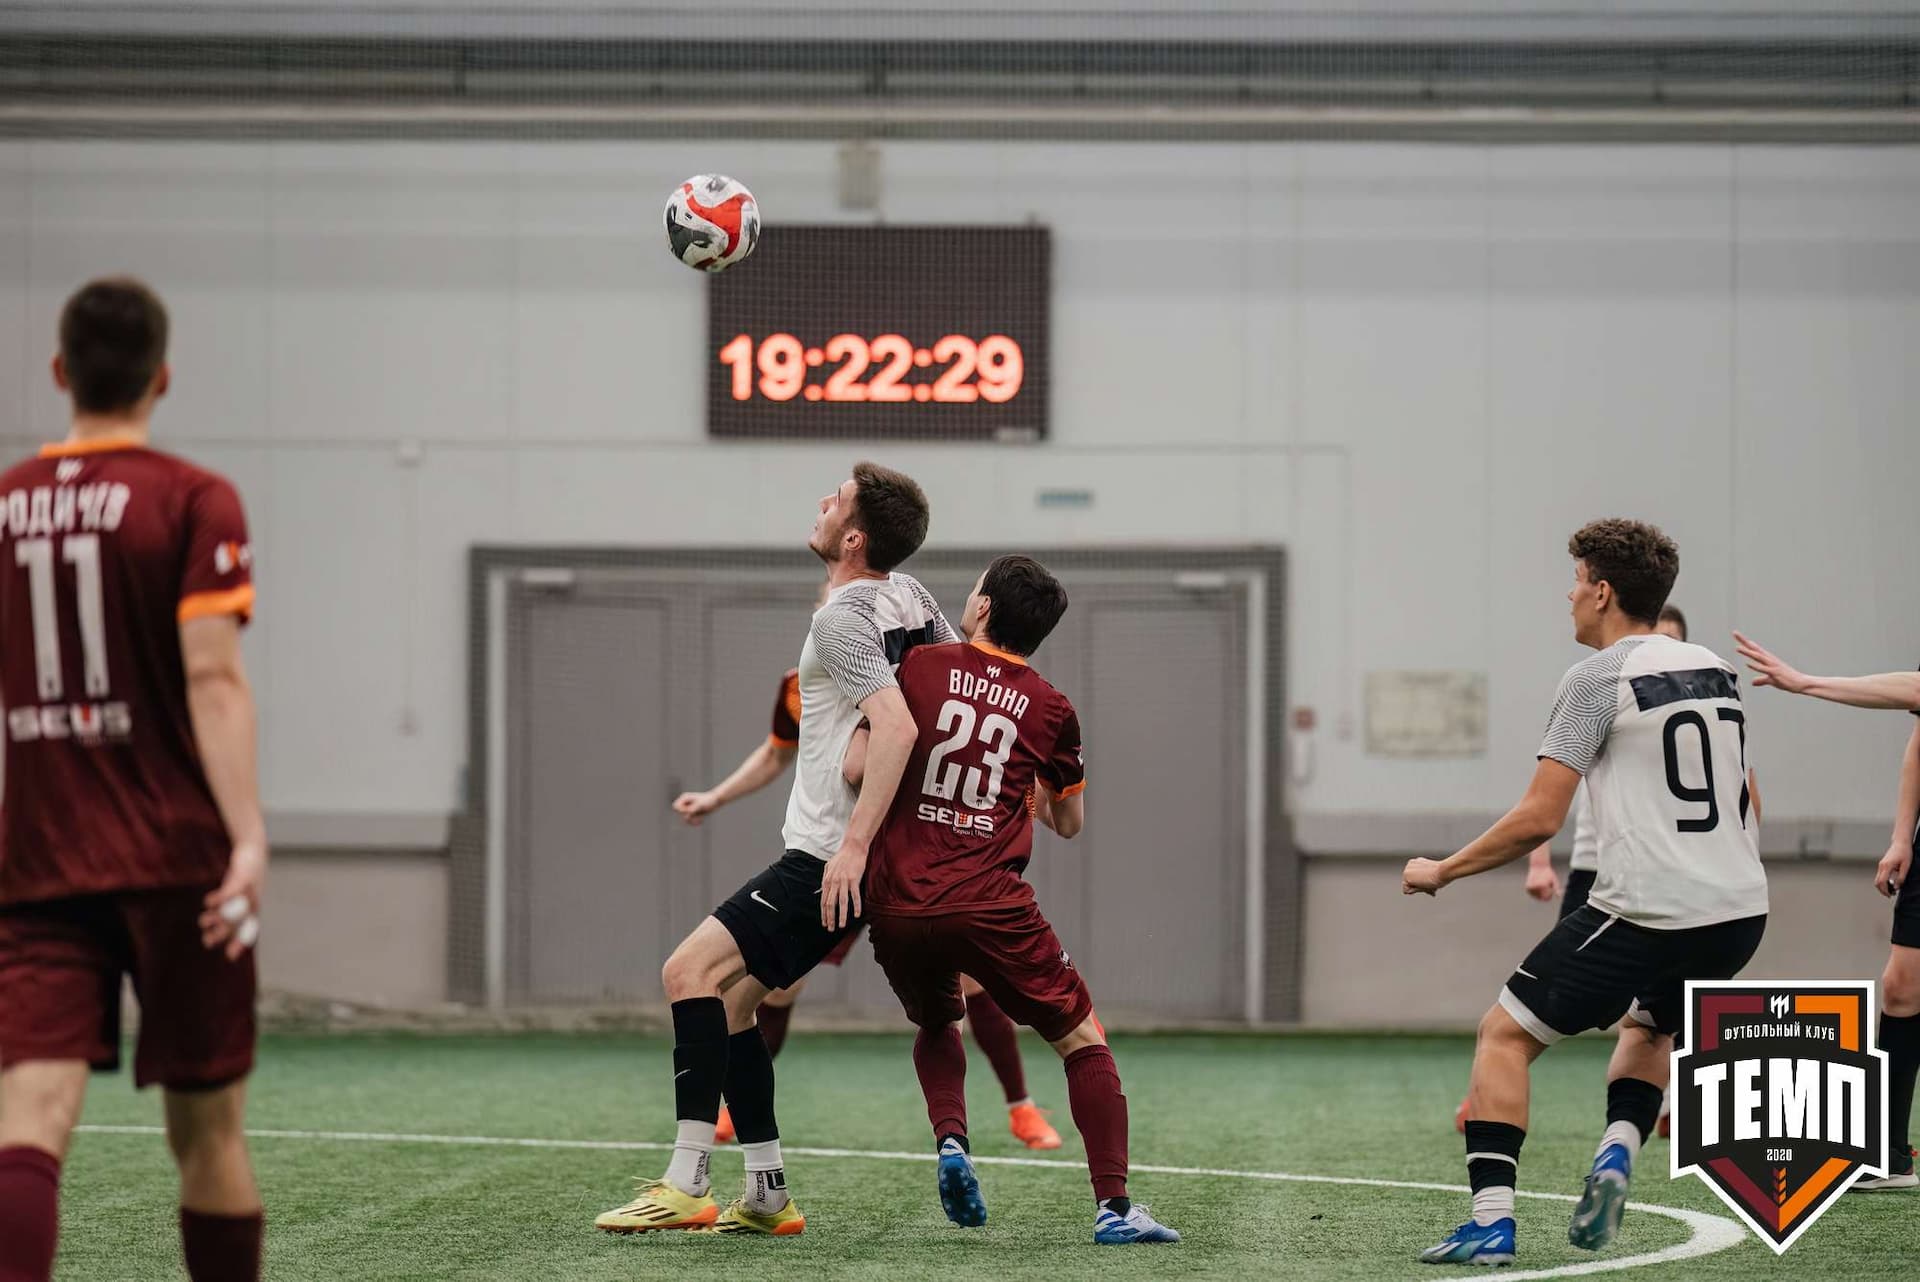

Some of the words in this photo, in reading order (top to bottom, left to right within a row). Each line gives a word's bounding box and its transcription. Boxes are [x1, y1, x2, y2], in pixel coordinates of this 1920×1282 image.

[719, 332, 1025, 403] 19:22:29
[14, 533, 110, 699] 11
[949, 668, 1030, 720] ВОРОНА
[921, 699, 1018, 811] 23
[1662, 707, 1750, 833] 97
[917, 803, 994, 832] SEUS
